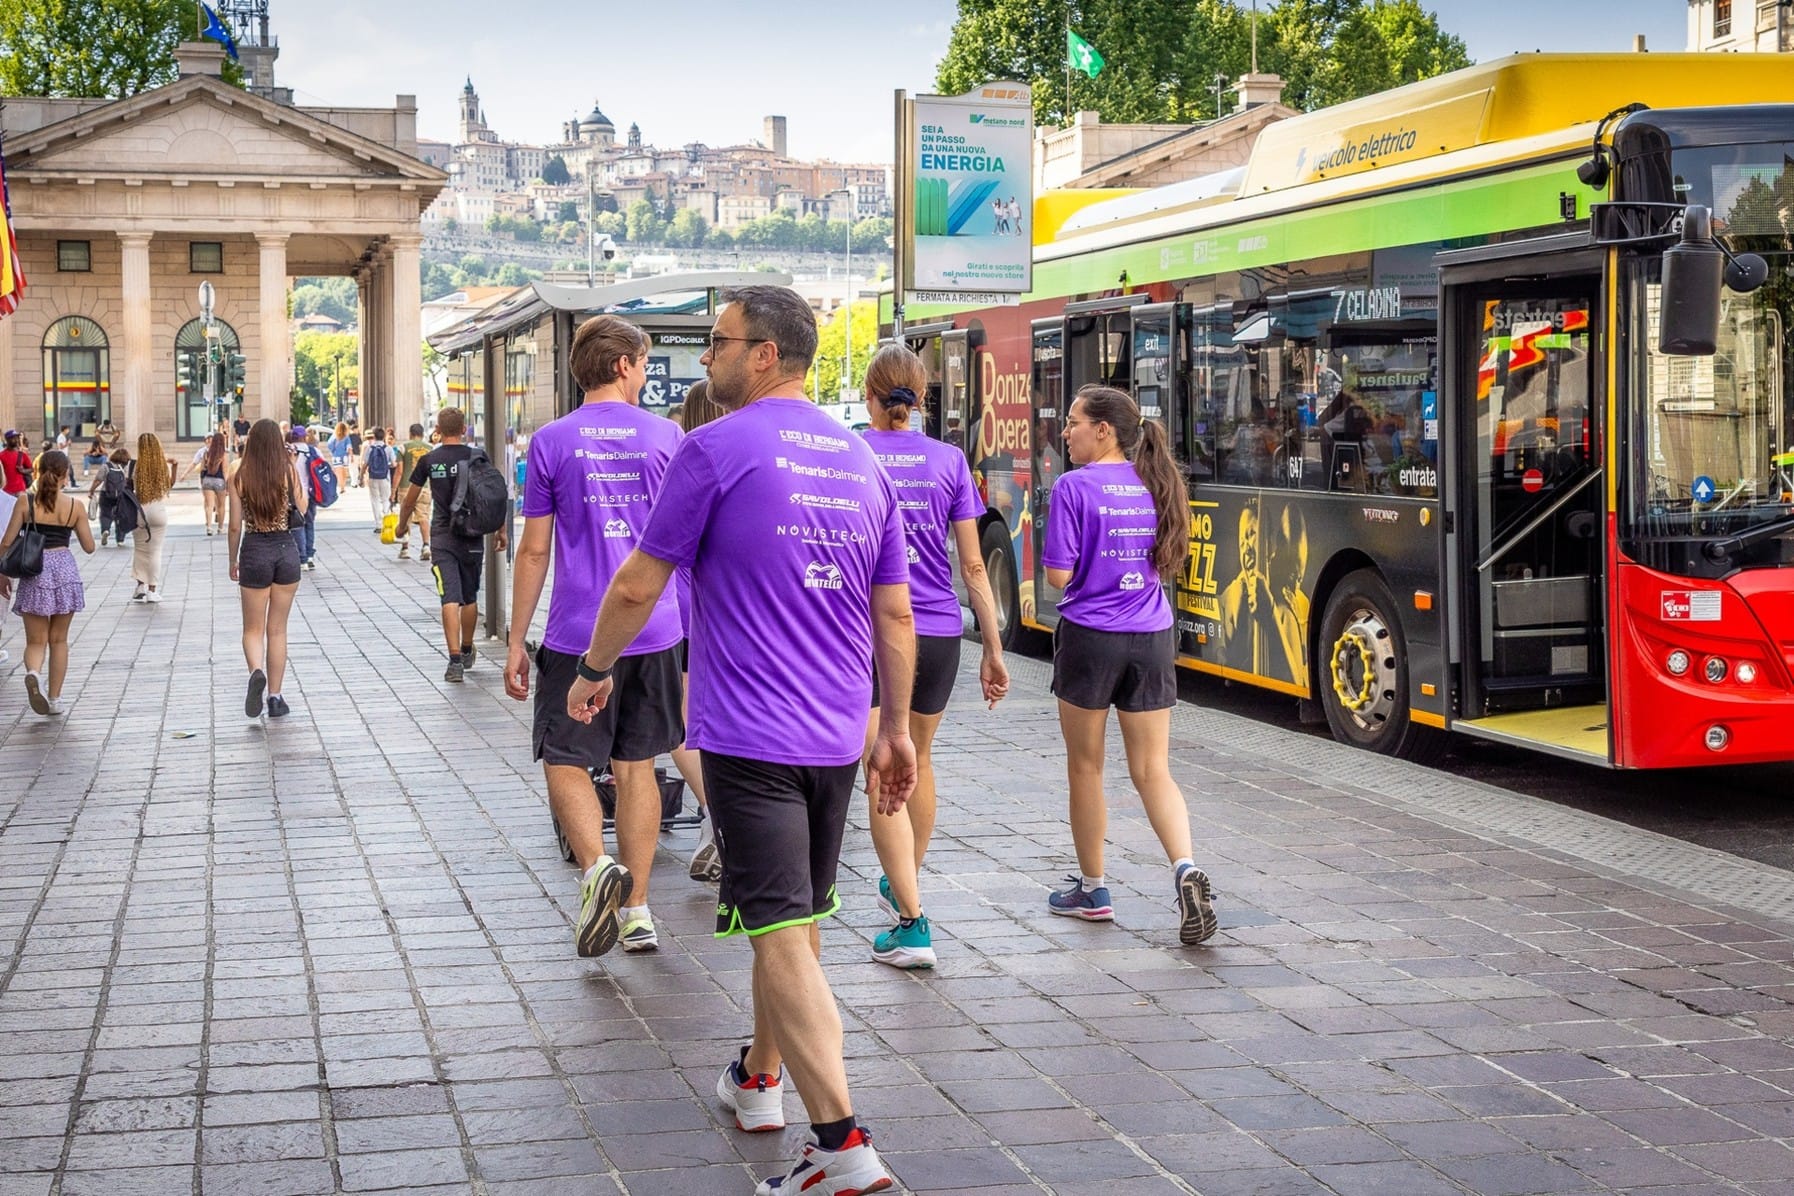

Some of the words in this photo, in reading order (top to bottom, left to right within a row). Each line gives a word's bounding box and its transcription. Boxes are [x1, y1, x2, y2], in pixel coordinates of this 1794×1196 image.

[921, 125, 936, 133] SEI
[937, 126, 944, 134] A
[921, 134, 934, 143] UN
[935, 135, 966, 144] PASSO
[921, 144, 934, 152] DA
[935, 144, 954, 153] UNA
[955, 145, 986, 154] NUOVA
[1313, 140, 1357, 171] veicolo
[1358, 127, 1417, 161] elettrico
[921, 153, 1006, 172] ENERGIA
[967, 262, 988, 270] Girati
[994, 263, 1024, 271] scoprila
[942, 270, 954, 278] nel
[1004, 271, 1024, 279] store
[916, 292, 951, 302] FERMATA
[951, 294, 958, 302] A
[958, 293, 998, 304] RICHIESTA
[1330, 289, 1346, 324] 7
[1346, 286, 1401, 321] CELADINA
[660, 335, 705, 344] IGPDecaux
[1144, 334, 1160, 351] exit
[642, 379, 666, 405] &
[982, 404, 1031, 458] Opera
[584, 450, 649, 460] TenarisDalmine
[787, 461, 868, 485] TenarisDalmine
[1289, 456, 1303, 478] 647
[1400, 466, 1437, 487] entrata
[583, 494, 649, 503] NOVISTECH
[777, 524, 866, 545] NOVISTECH
[1101, 548, 1153, 557] NOVISTE
